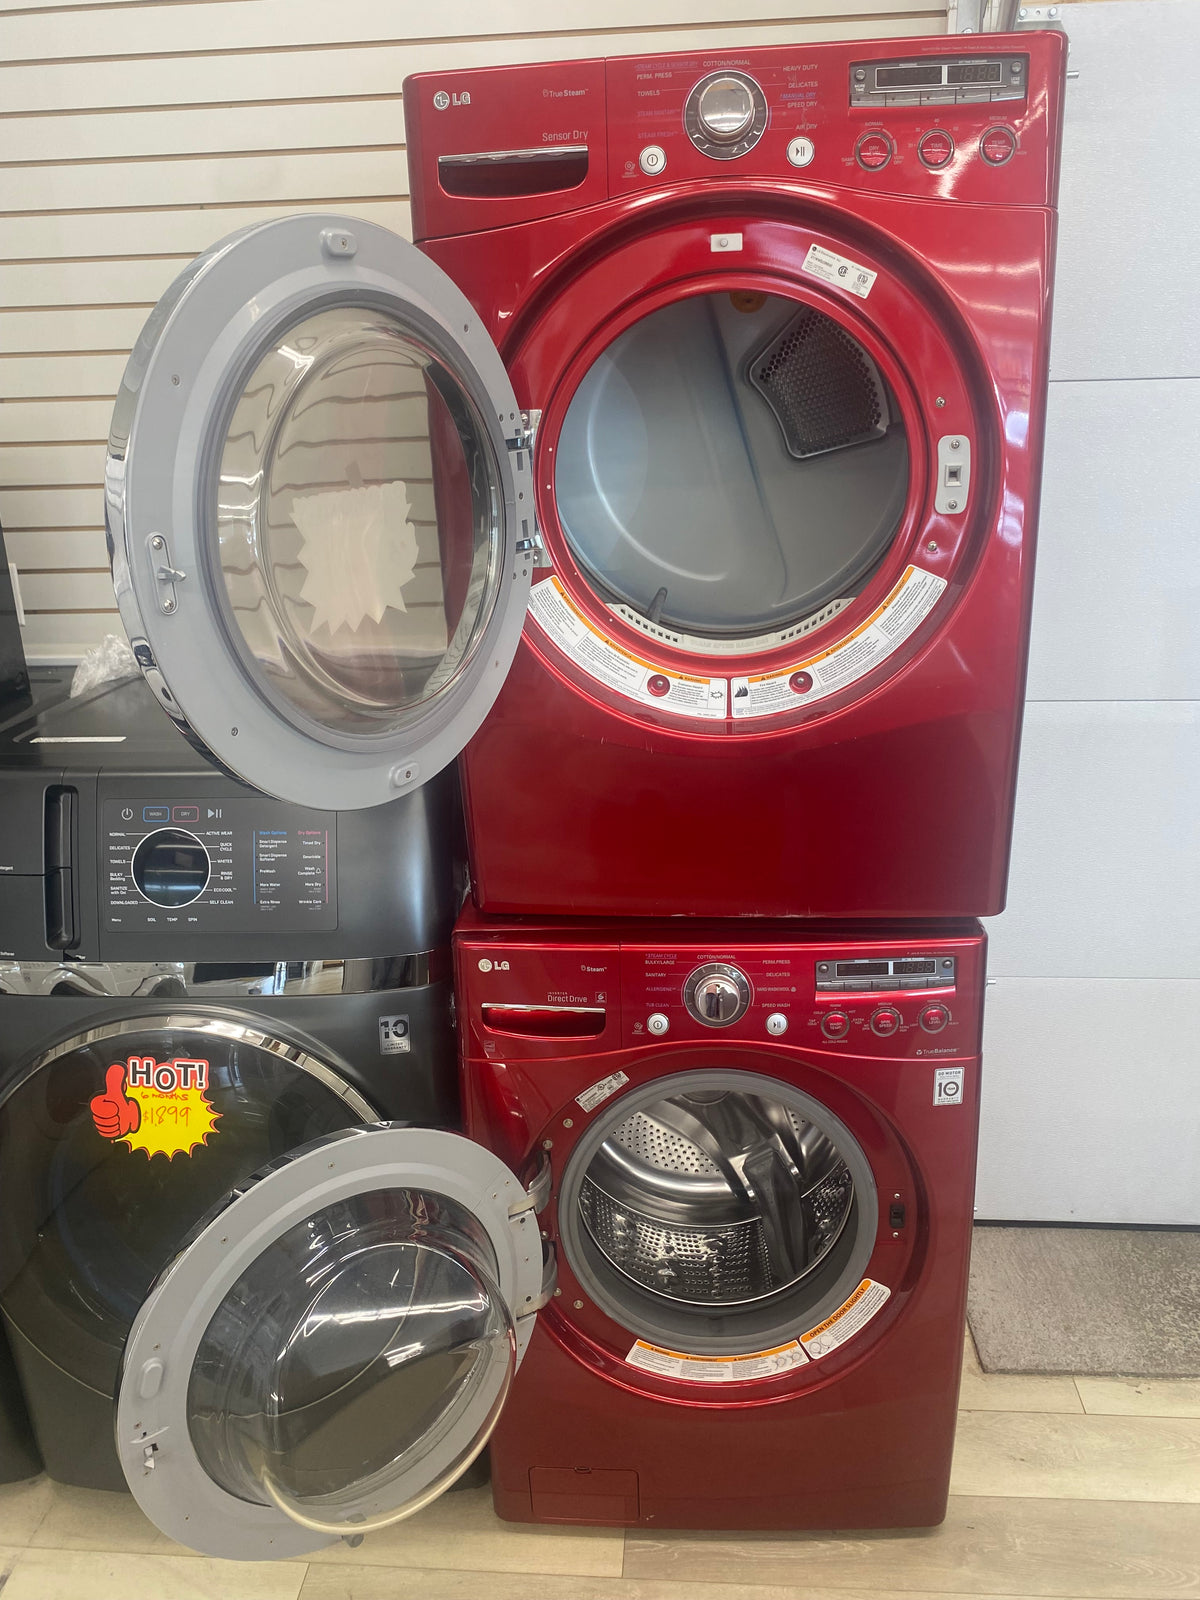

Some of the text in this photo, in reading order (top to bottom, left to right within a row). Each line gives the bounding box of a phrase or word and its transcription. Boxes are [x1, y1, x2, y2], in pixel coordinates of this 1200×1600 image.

[788, 81, 818, 89] DELICATES
[452, 92, 471, 106] LG
[542, 130, 590, 143] Sensor Dry
[494, 961, 510, 971] LG
[548, 994, 589, 1003] Direct Drive
[380, 1019, 409, 1039] 10
[130, 1059, 206, 1092] HOT!
[140, 1091, 150, 1099] 6
[938, 1081, 960, 1097] 10
[809, 1287, 865, 1339] OPEN THE DOOR SLIGHTLY
